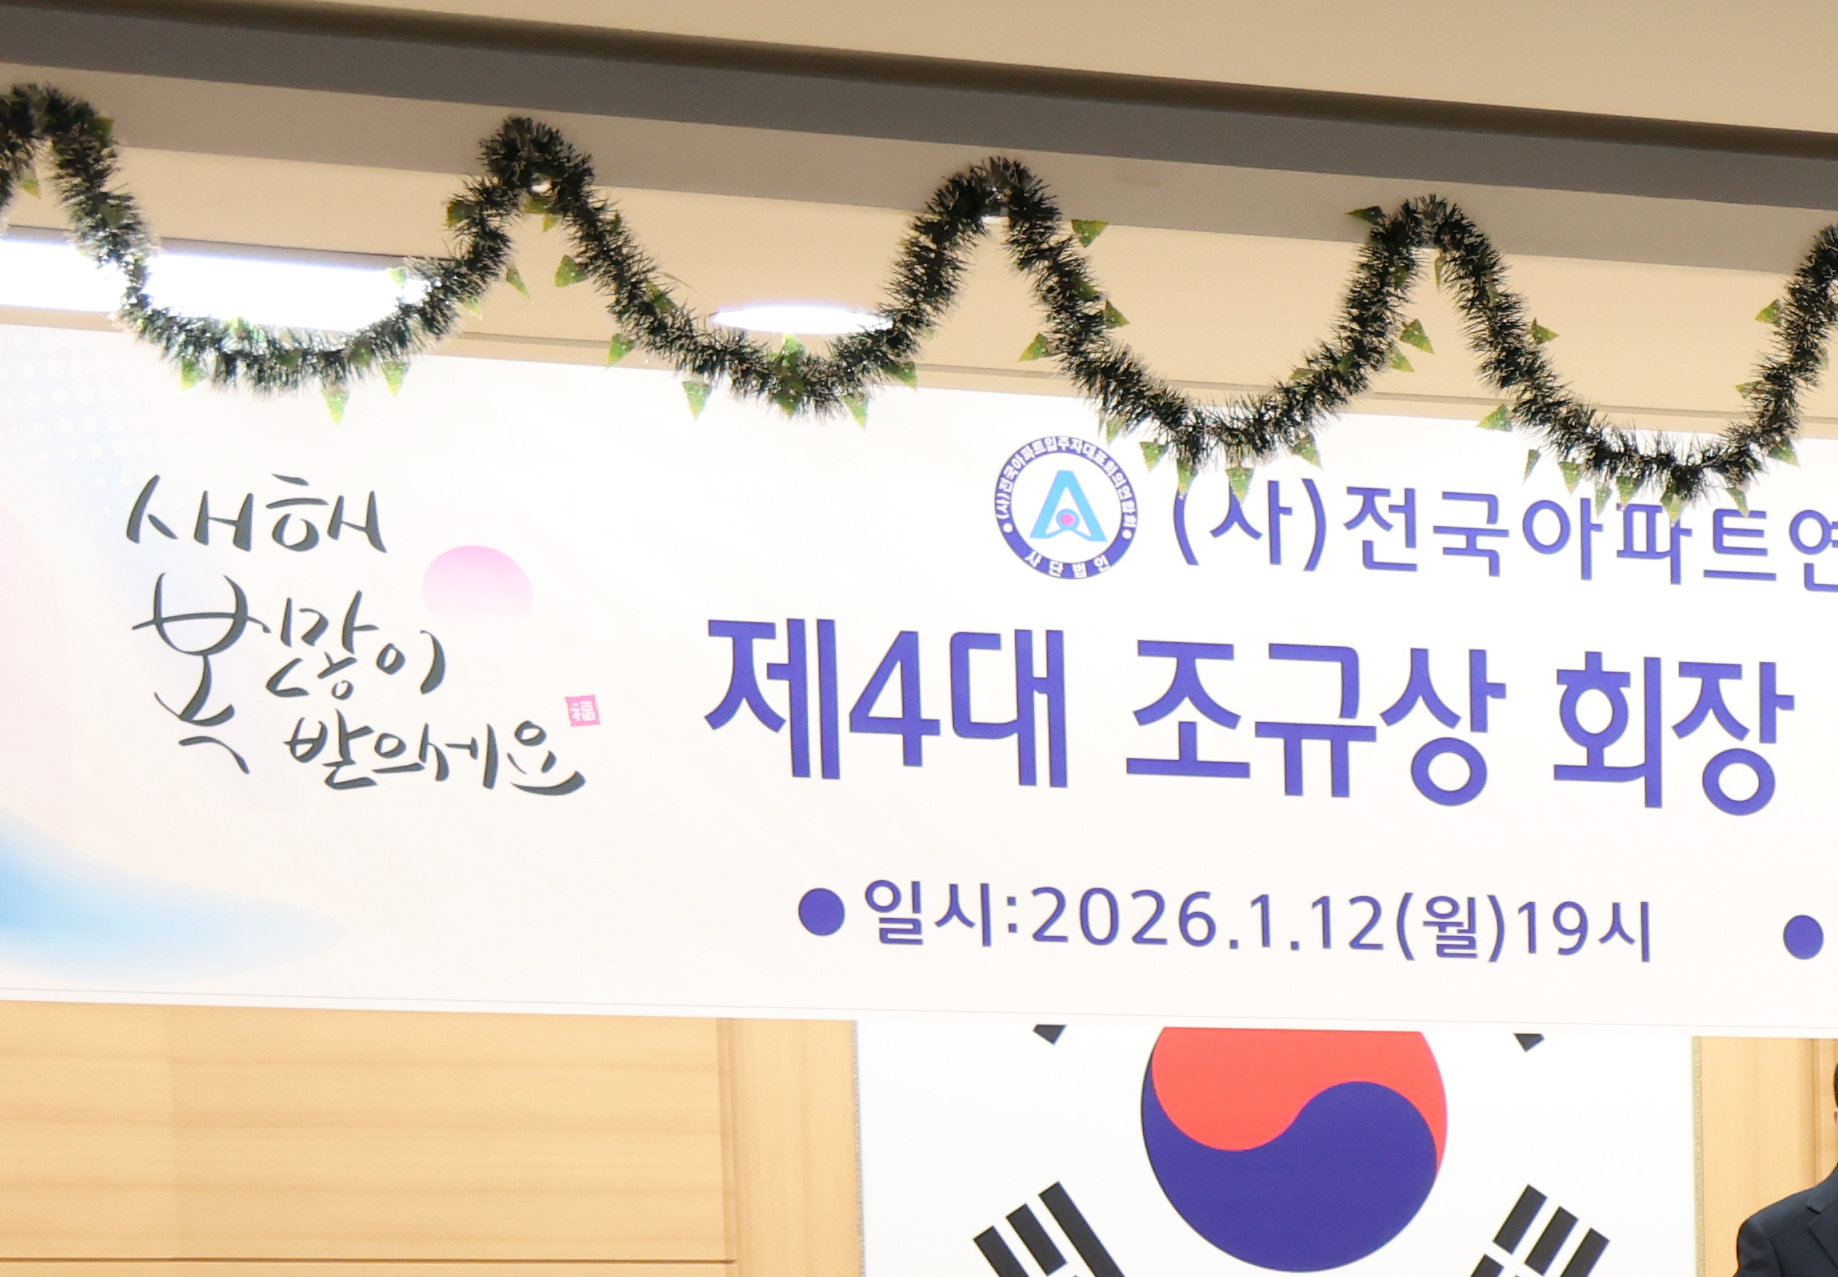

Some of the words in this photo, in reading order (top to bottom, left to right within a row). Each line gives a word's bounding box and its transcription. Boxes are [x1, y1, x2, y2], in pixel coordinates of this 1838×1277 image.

[126, 474, 388, 553] 새해
[131, 572, 272, 775] 복
[264, 590, 447, 701] 많이
[703, 617, 1069, 789] 제4대
[1125, 638, 1508, 807] 조규상
[1553, 650, 1796, 817] 회장
[864, 879, 1652, 964] 일시:2026.1.12(월)19시
